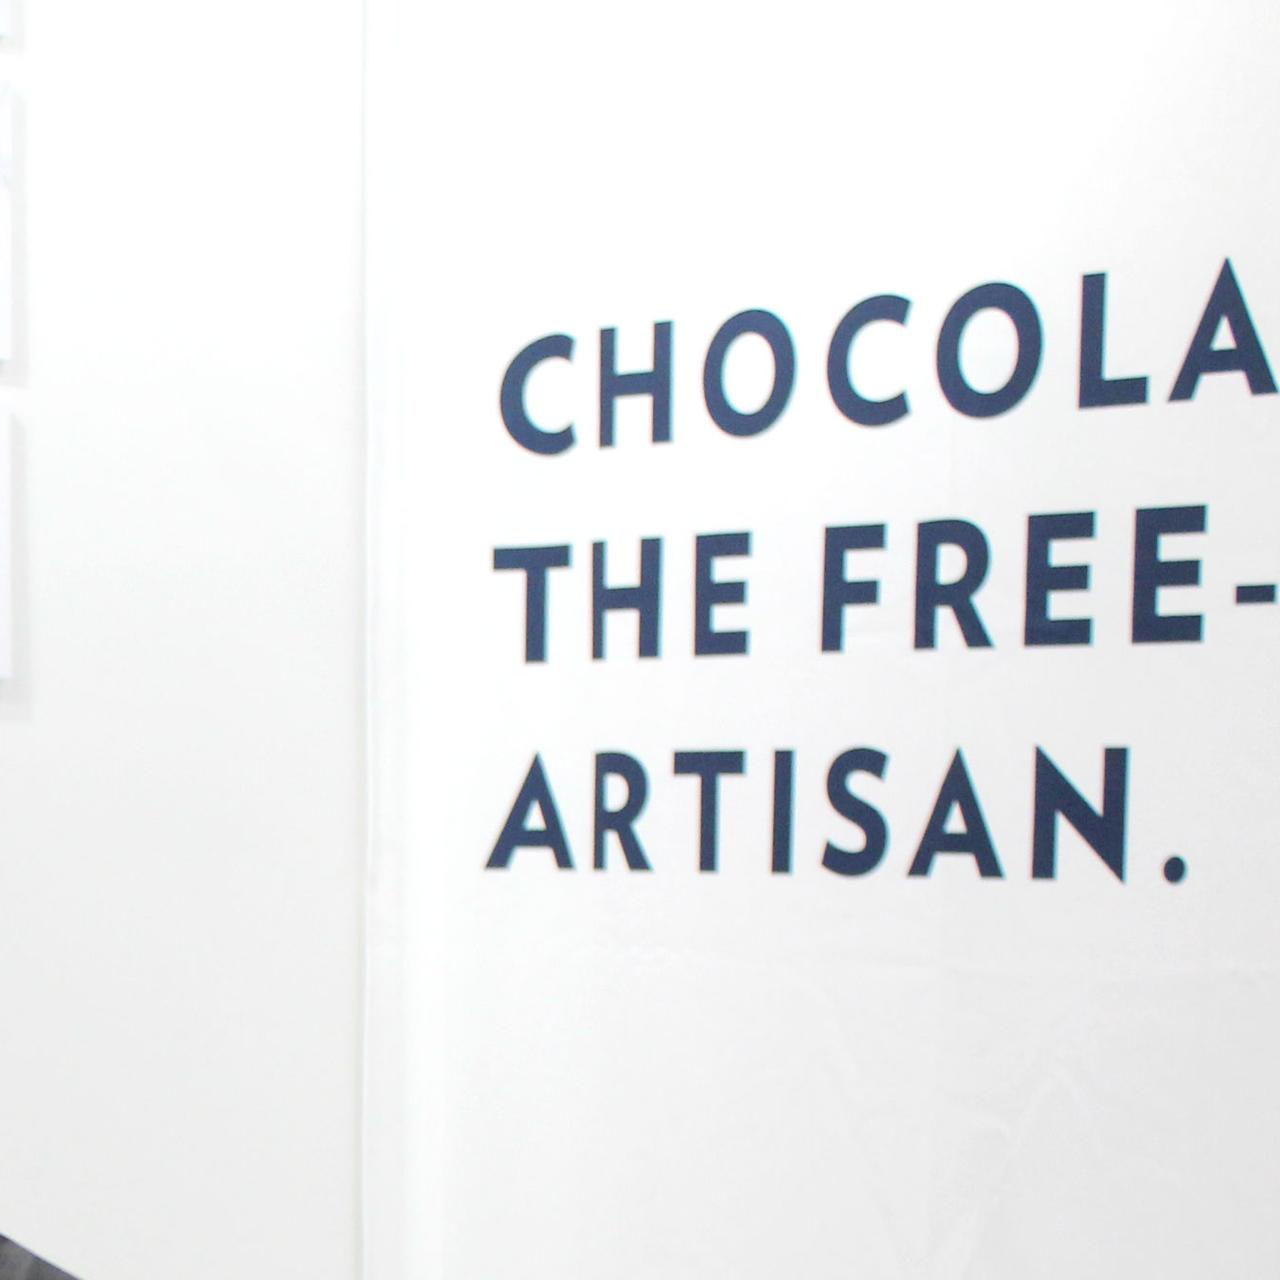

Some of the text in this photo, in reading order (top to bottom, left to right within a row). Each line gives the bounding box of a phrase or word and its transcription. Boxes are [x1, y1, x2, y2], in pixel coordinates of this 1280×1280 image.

[499, 256, 1280, 457] CHOCOLA
[492, 504, 1278, 664] THE FREE-
[484, 744, 1188, 885] ARTISAN.
